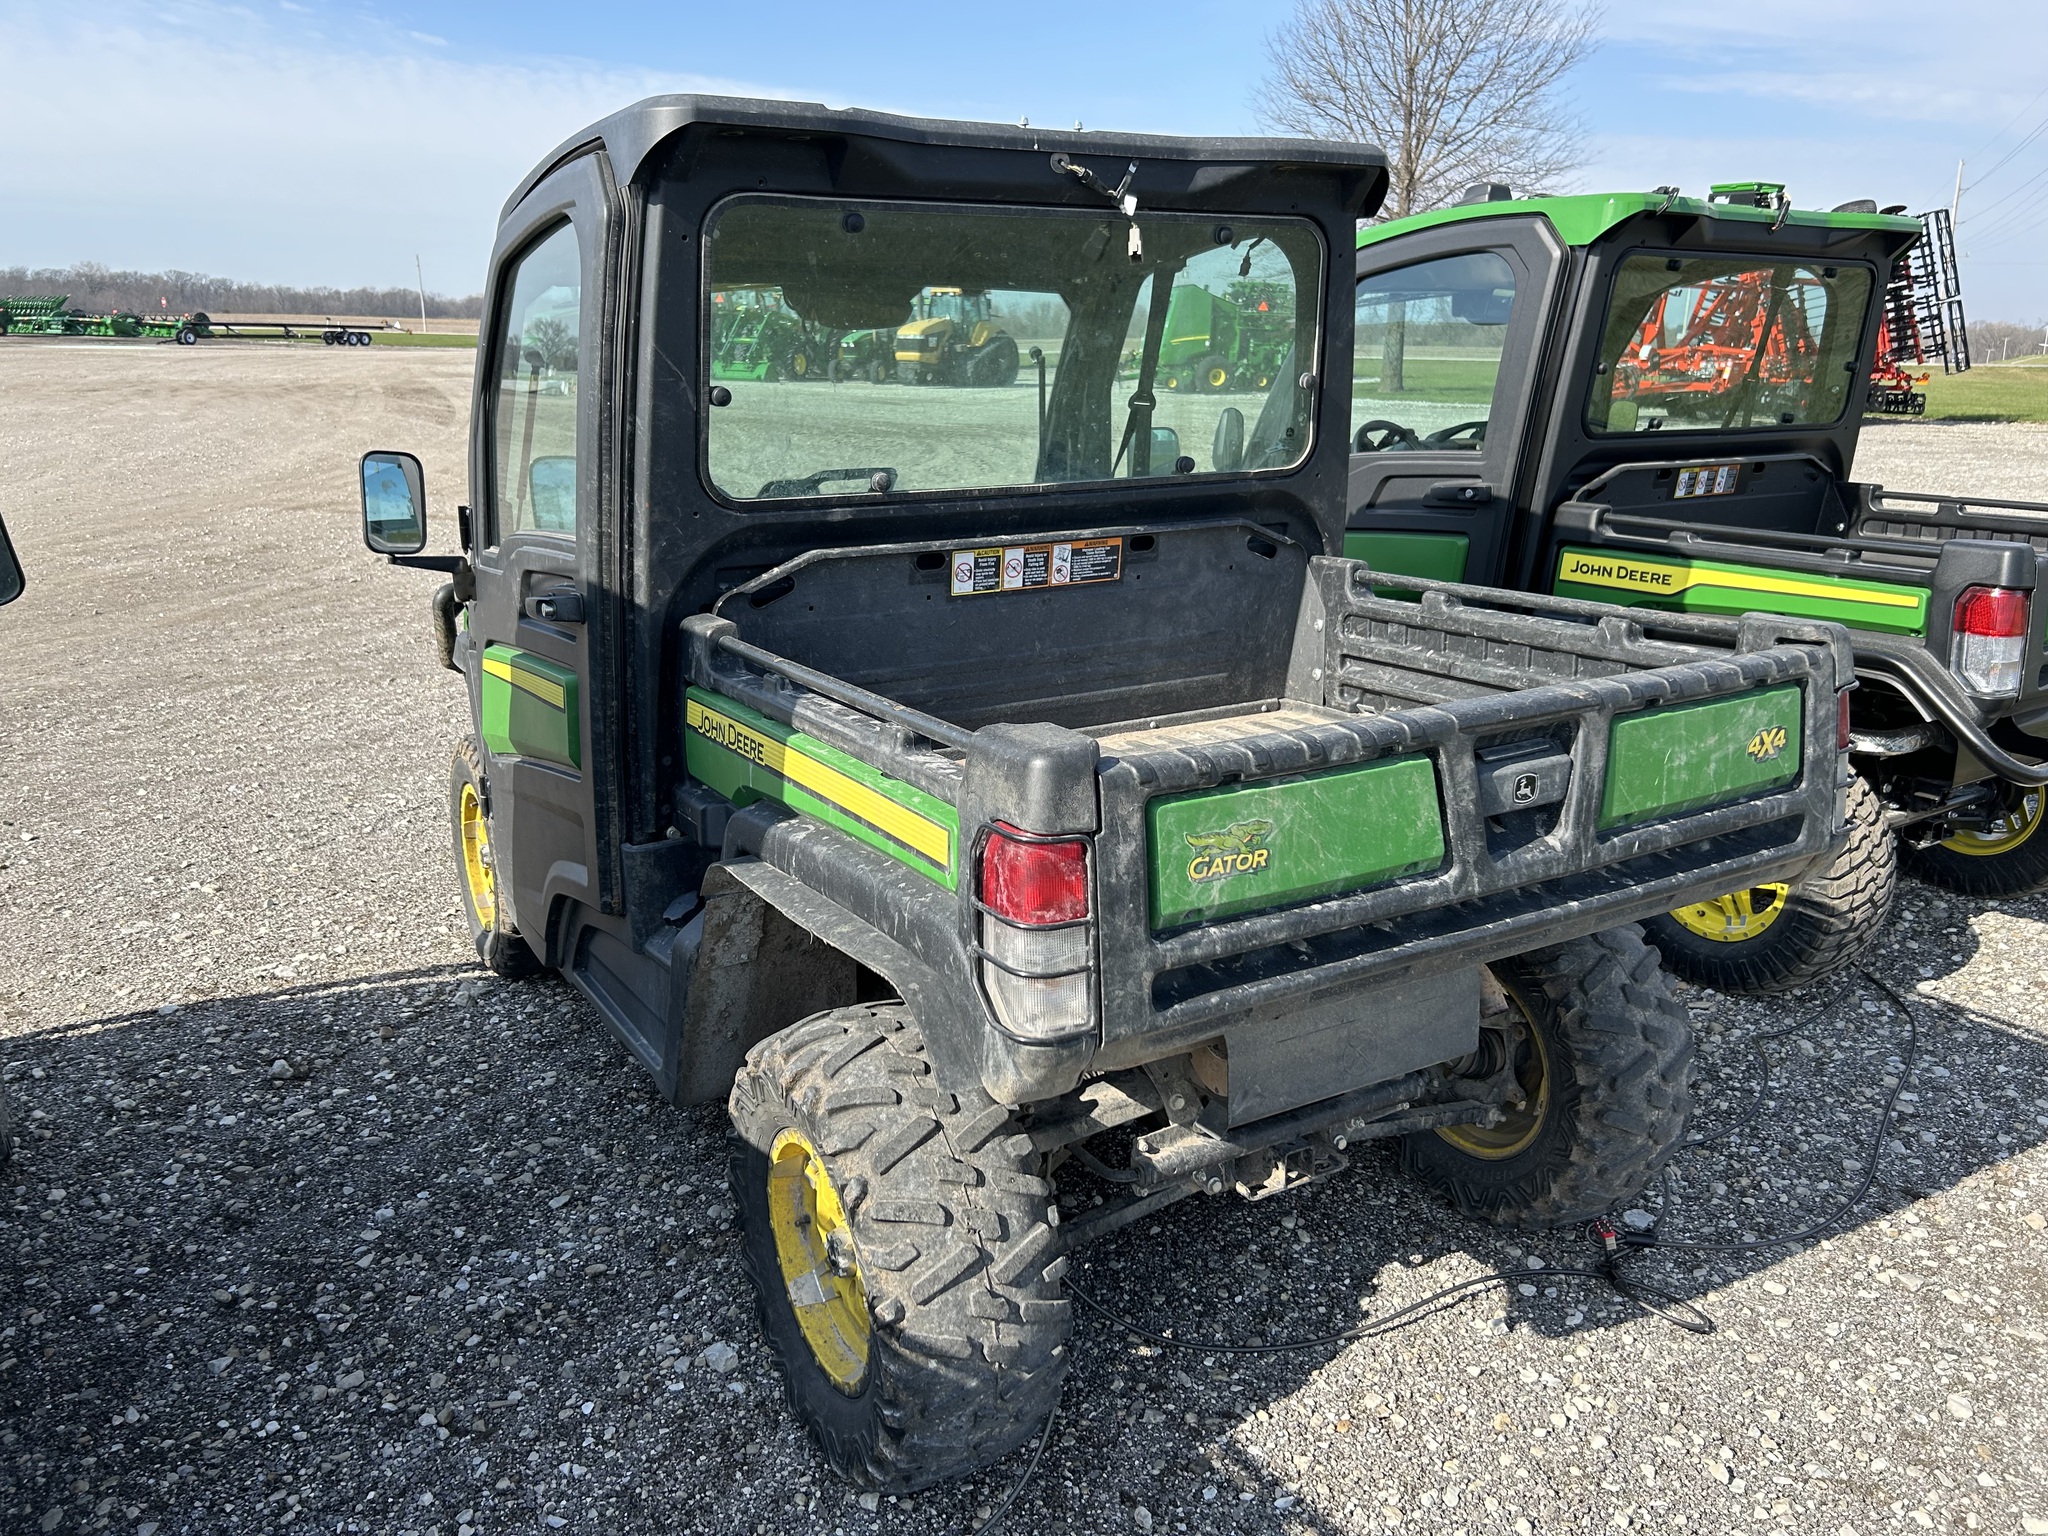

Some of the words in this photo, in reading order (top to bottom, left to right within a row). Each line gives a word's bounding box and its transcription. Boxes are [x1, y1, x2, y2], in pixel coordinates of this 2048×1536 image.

[1570, 560, 1613, 578] JOHN
[1616, 565, 1672, 586] DEERE
[697, 709, 726, 743] JOHN
[728, 722, 765, 764] DEERE
[1188, 848, 1269, 880] GATOR
